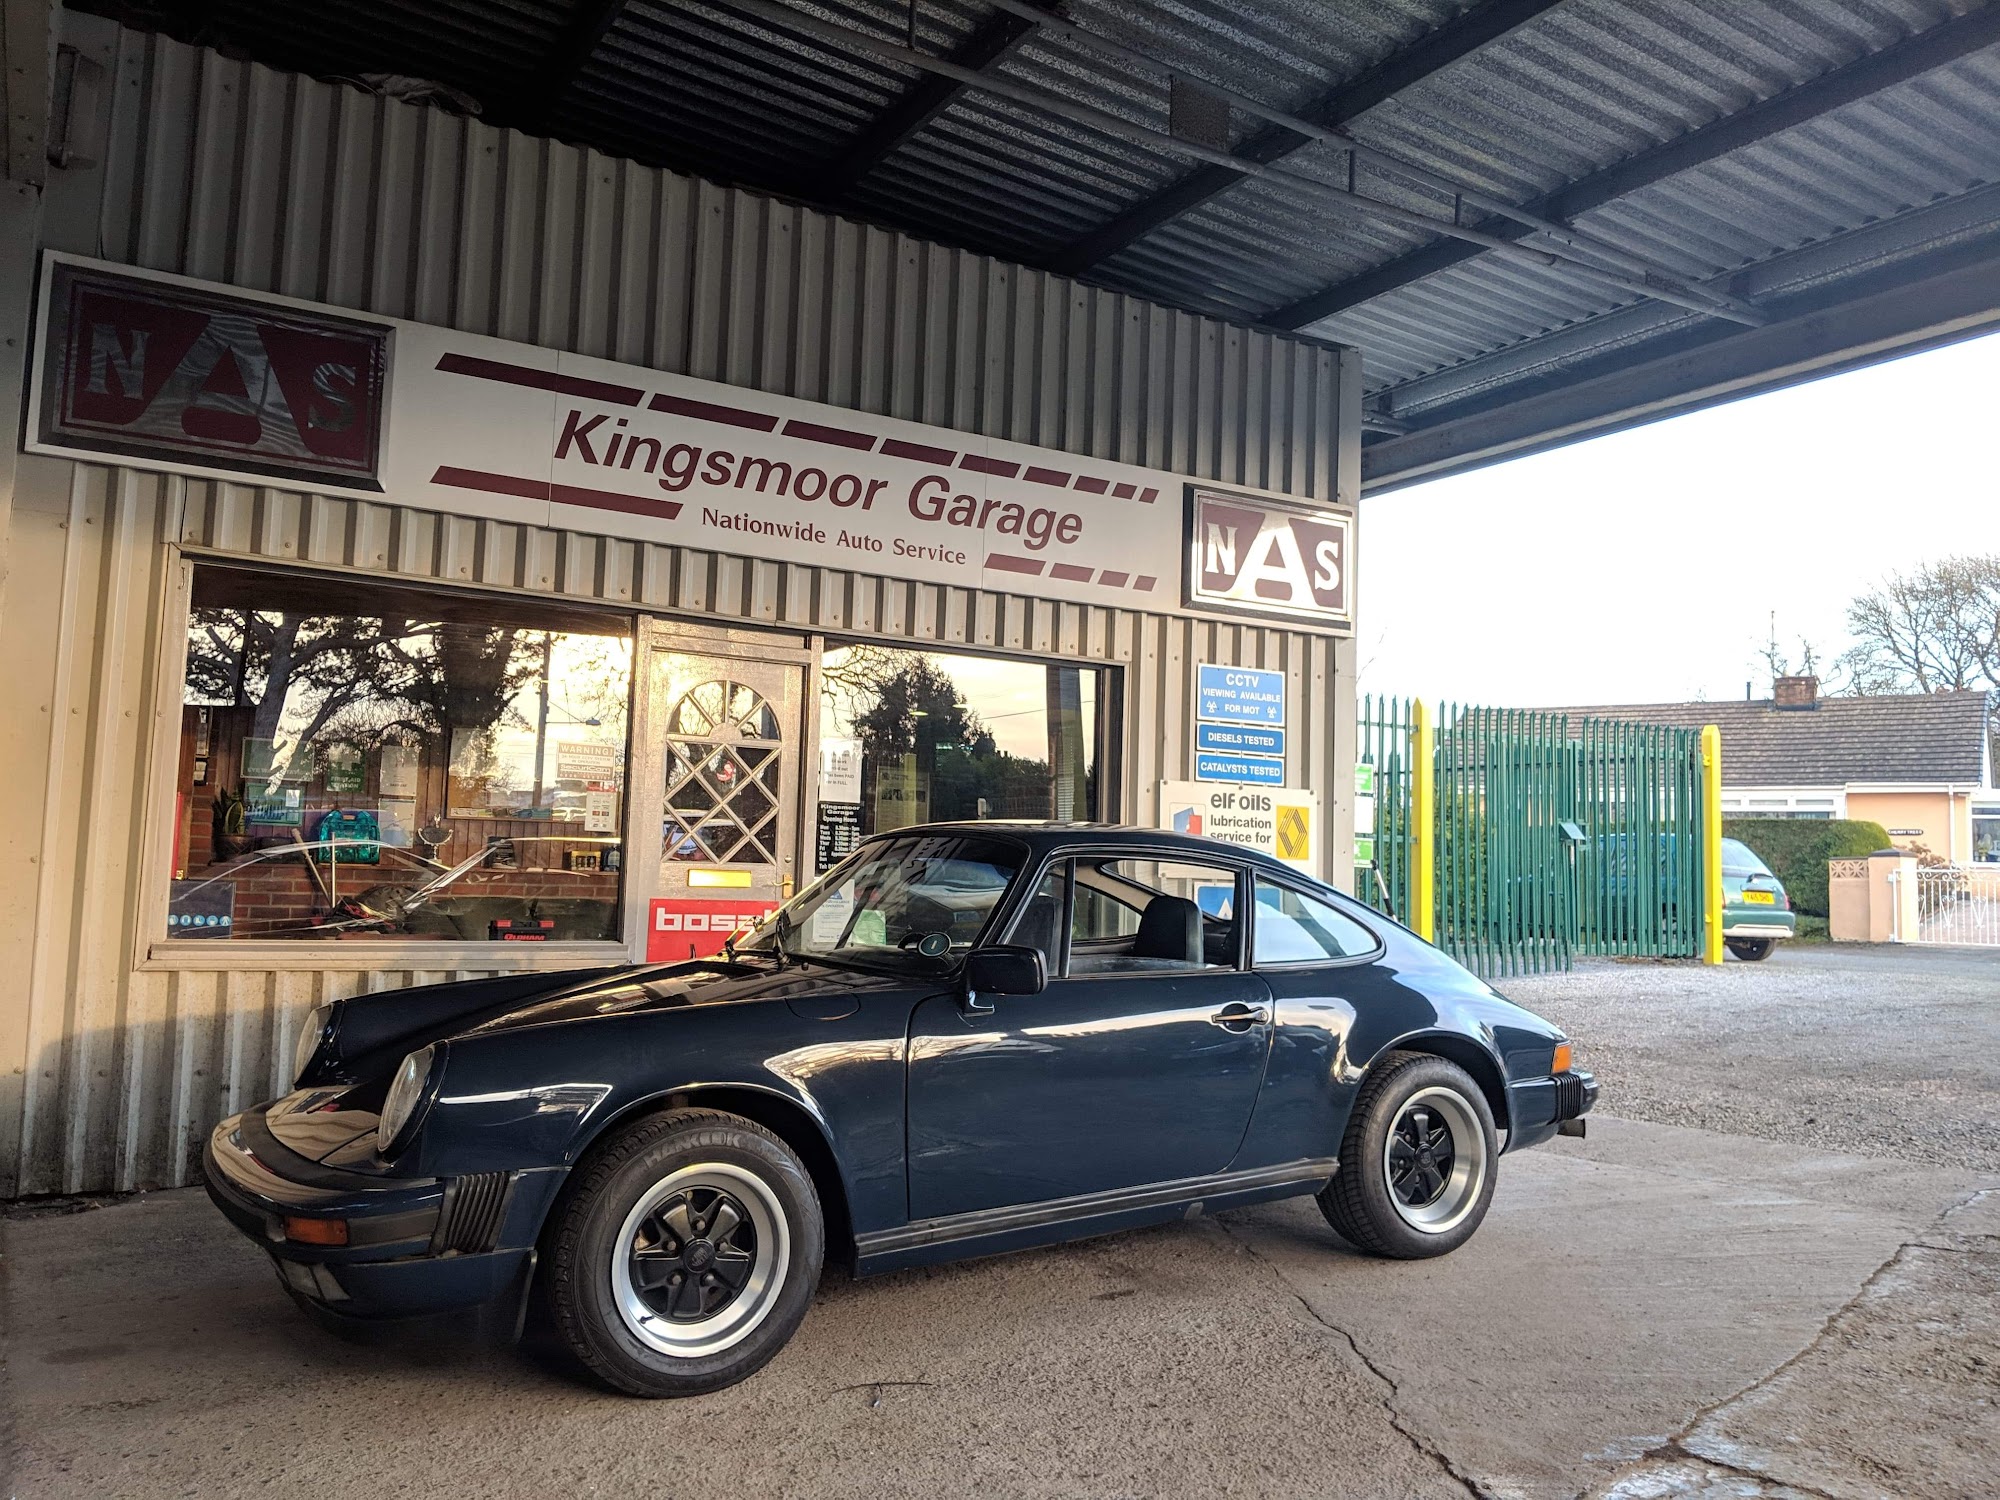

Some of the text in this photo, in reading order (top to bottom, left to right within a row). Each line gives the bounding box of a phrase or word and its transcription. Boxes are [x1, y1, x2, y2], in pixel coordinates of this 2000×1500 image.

[85, 308, 357, 458] NAS
[554, 409, 1083, 550] Kingsmoor Garage
[701, 507, 967, 566] Nationwide Auto Service
[1205, 512, 1340, 608] NAS
[1226, 673, 1259, 688] CCTV
[1202, 688, 1281, 703] VIEWING AVAILABLE
[1224, 704, 1260, 715] FOR MOT
[1208, 732, 1275, 747] DIESELS TESTED
[561, 744, 613, 756] WARNING!
[1201, 762, 1280, 777] CATALYSTS TESTED
[820, 803, 860, 811] Kingsmoor
[1210, 792, 1271, 812] elf oils
[823, 815, 843, 824] Opening
[1210, 814, 1272, 830] lubrication
[1210, 830, 1271, 844] service for
